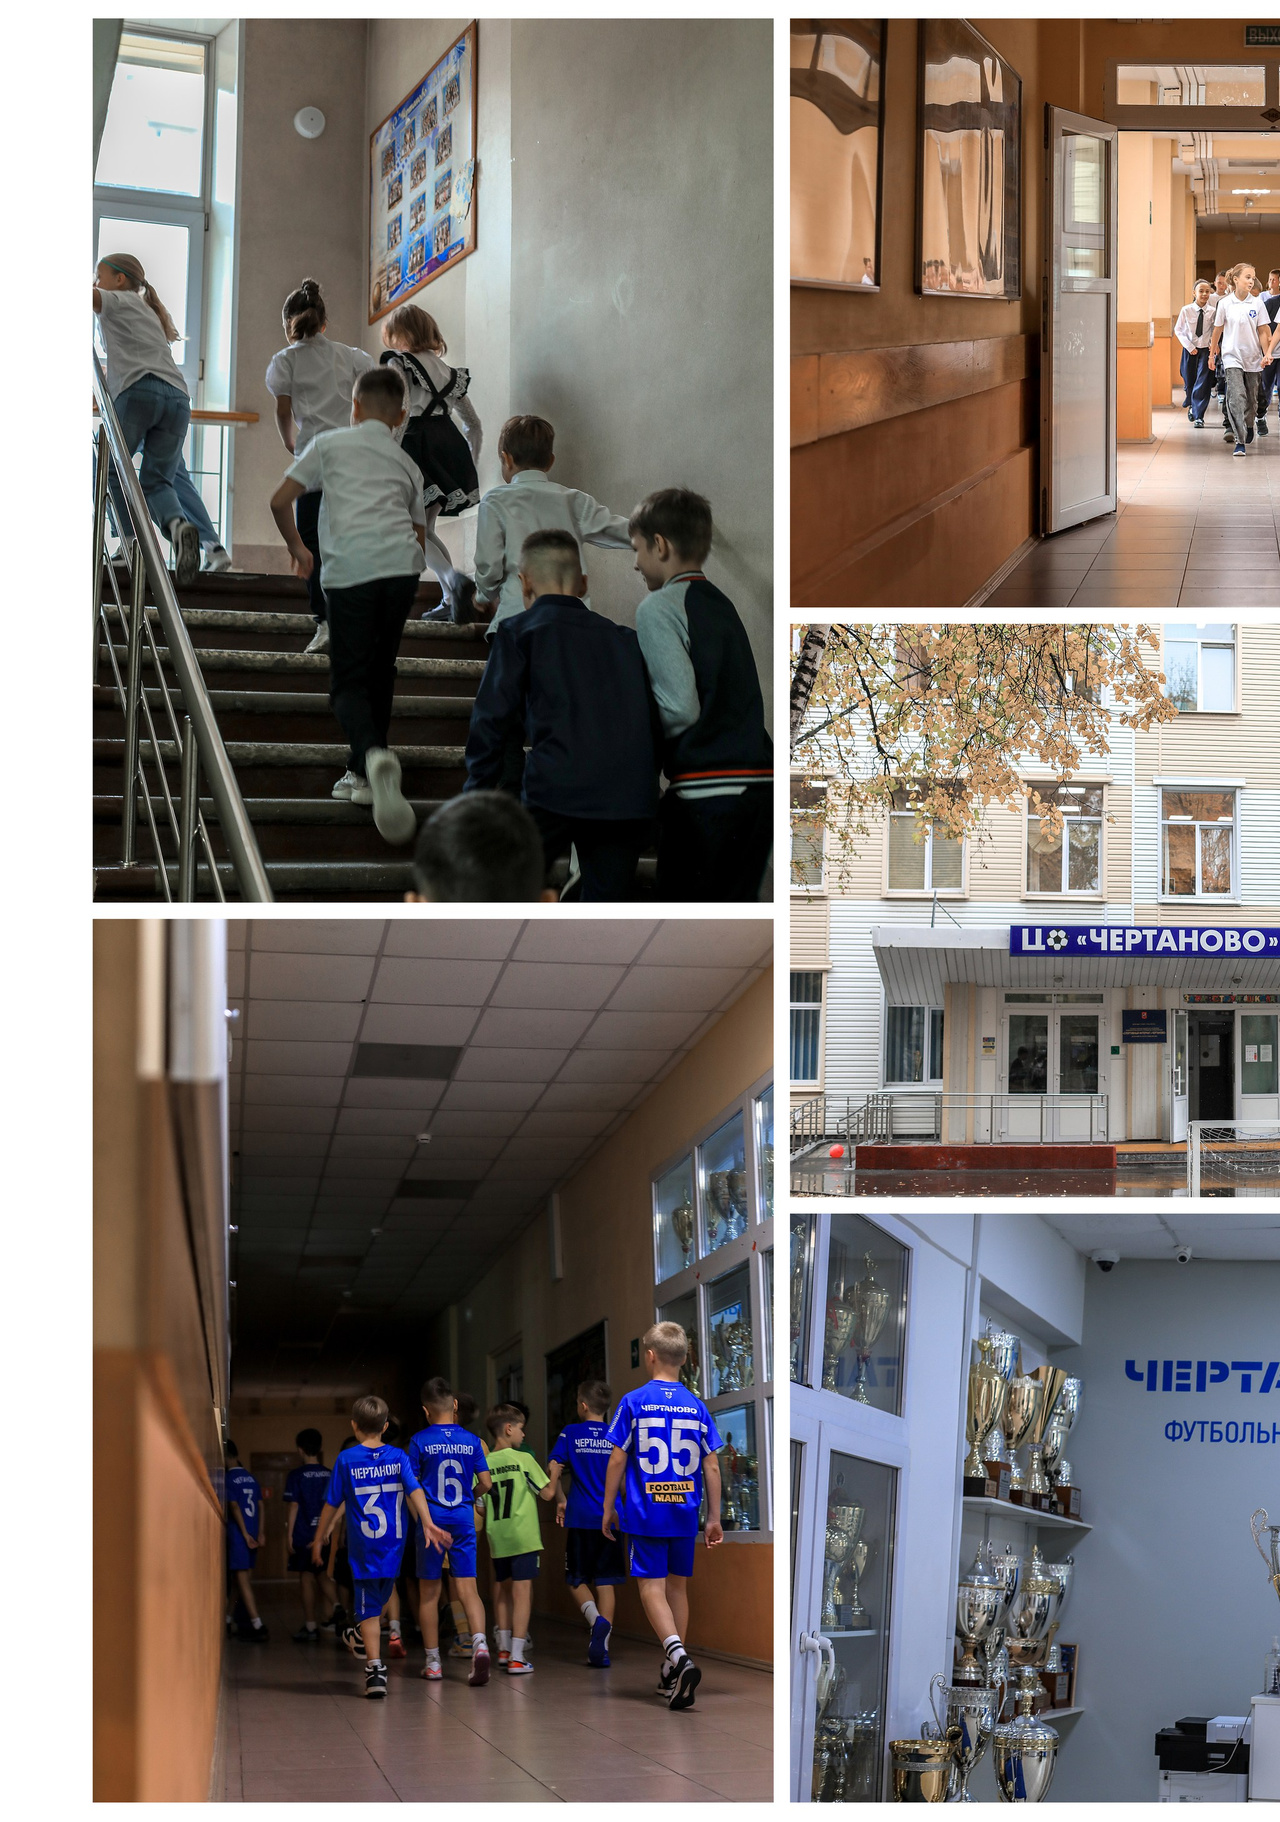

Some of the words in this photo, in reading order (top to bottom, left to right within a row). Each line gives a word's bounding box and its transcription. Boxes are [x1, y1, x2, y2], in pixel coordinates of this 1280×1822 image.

[1076, 929, 1280, 952] «ЧЕРТАНОВО»
[641, 1404, 698, 1415] ЧЕРТАНОВО
[425, 1443, 474, 1456] ЧЕРТАНОВО
[638, 1417, 700, 1476] 55
[351, 1463, 402, 1480] ЧЕРТАНОВО
[437, 1459, 463, 1507] 6
[649, 1483, 690, 1492] FOOTBALL
[243, 1488, 256, 1518] 3
[487, 1479, 514, 1521] 17
[654, 1494, 685, 1503] MANIA
